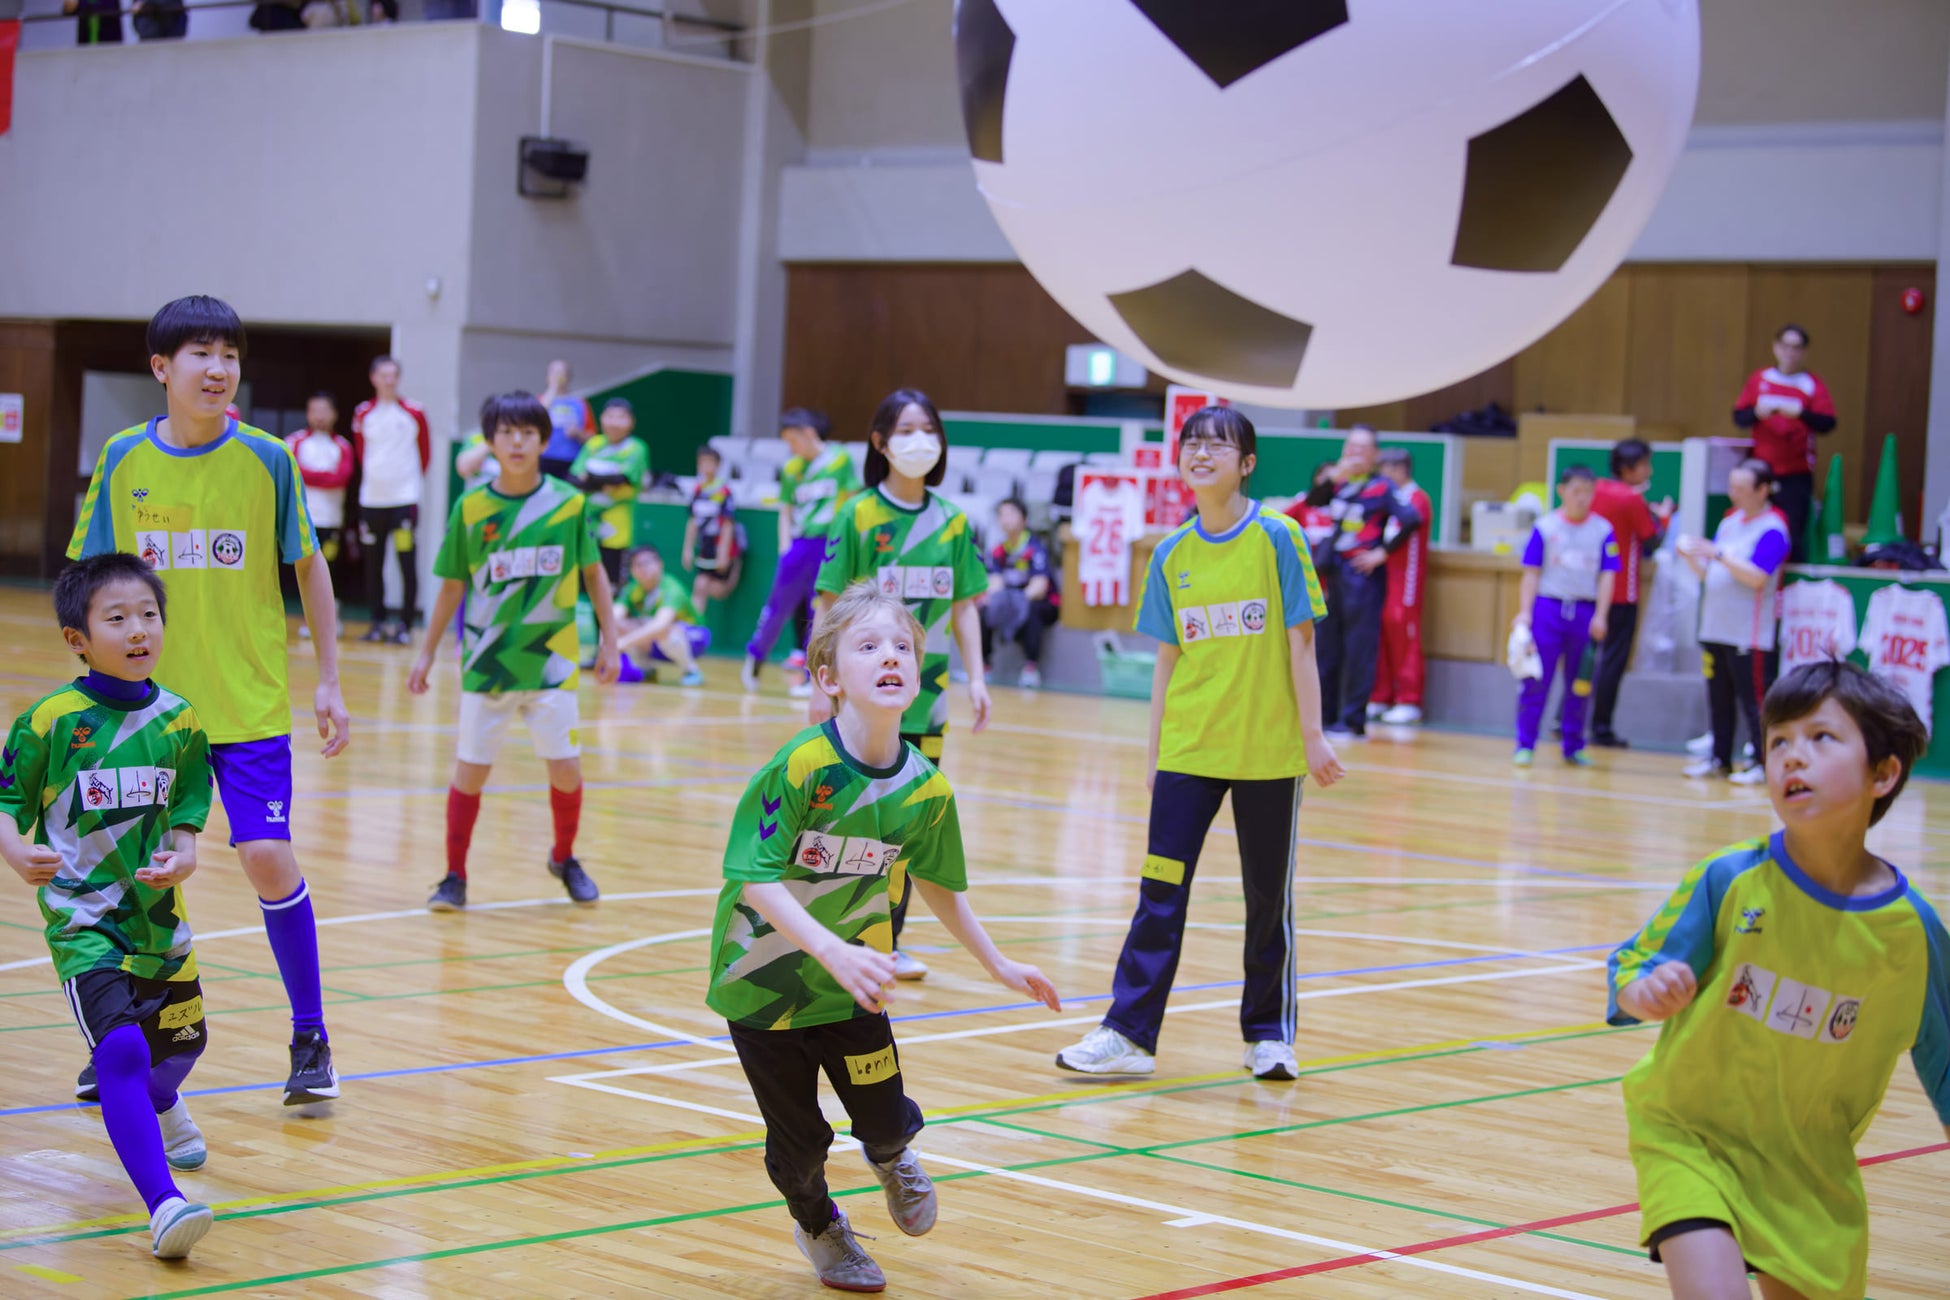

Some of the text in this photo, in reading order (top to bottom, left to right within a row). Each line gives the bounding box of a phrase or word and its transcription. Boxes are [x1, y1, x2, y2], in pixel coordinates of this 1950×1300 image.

[138, 508, 170, 523] ゆうせい
[1090, 518, 1123, 555] 26
[172, 1031, 200, 1042] adidas
